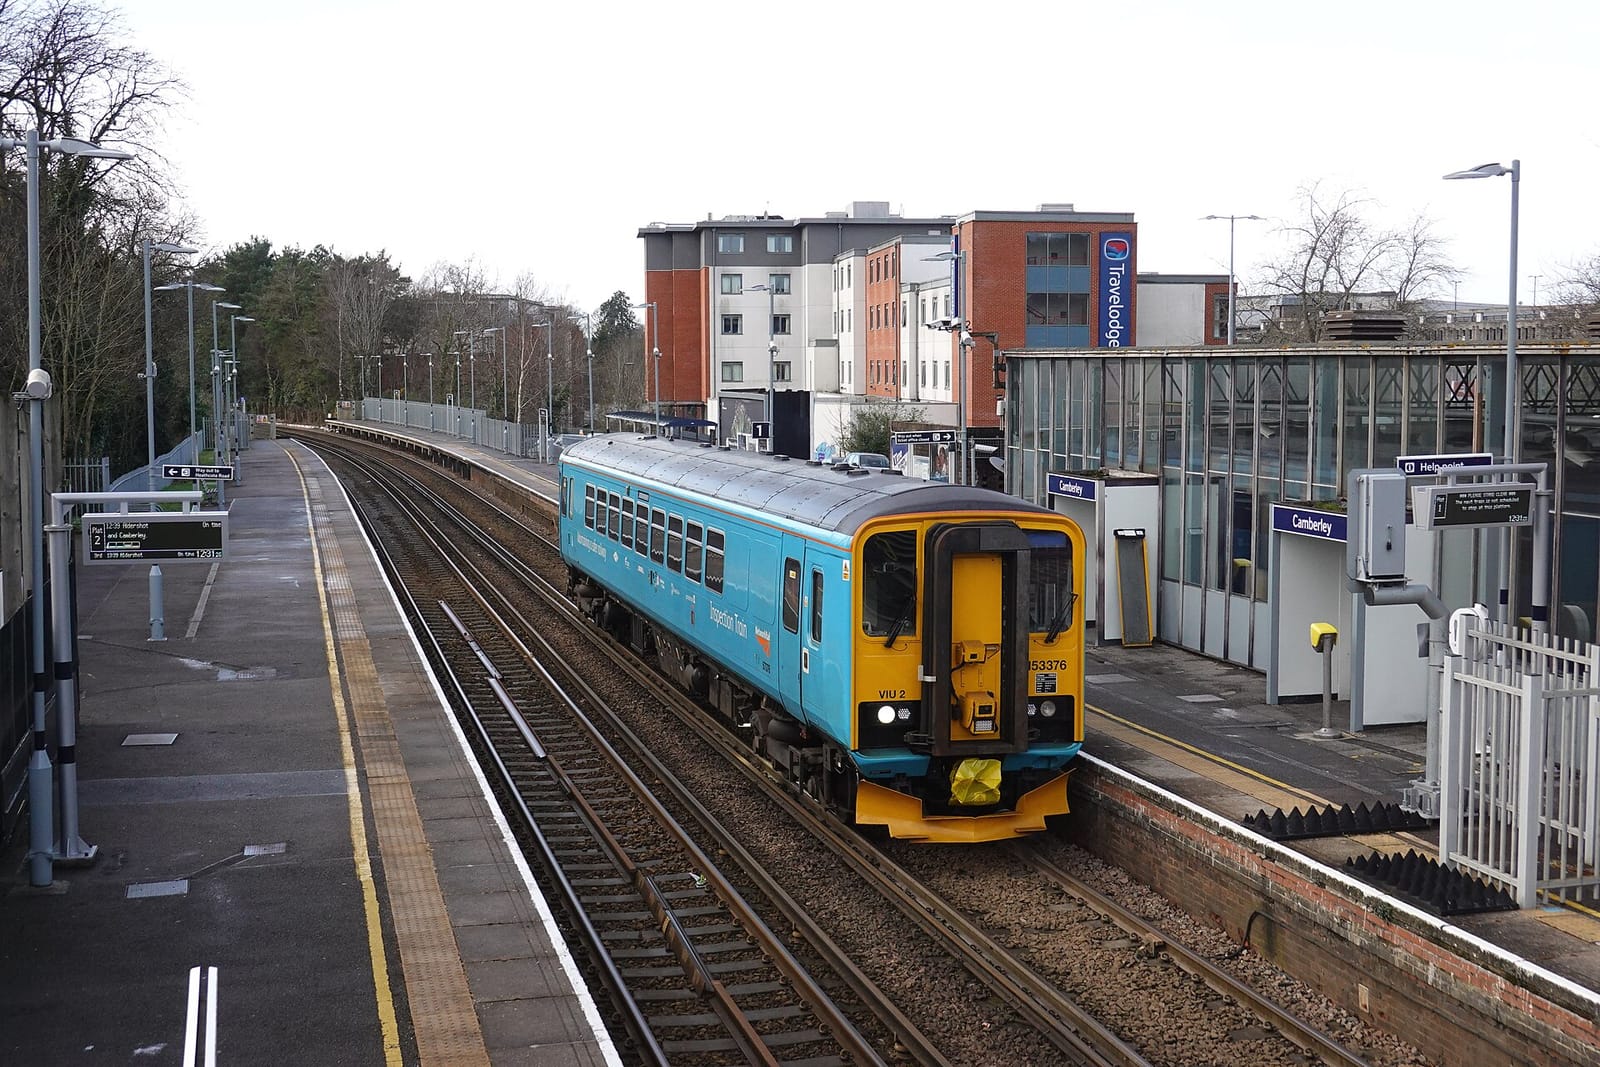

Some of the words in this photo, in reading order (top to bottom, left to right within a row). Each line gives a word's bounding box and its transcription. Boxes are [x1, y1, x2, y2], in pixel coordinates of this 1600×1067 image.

[1105, 263, 1125, 348] Travelodge
[756, 424, 762, 437] 1
[1420, 462, 1440, 473] Help
[1059, 480, 1083, 497] Camberley
[1292, 514, 1332, 537] Camberley
[94, 535, 101, 545] 2
[709, 600, 735, 633] Inspection
[734, 613, 748, 639] Train
[878, 690, 896, 699] VIU
[897, 690, 906, 698] 2
